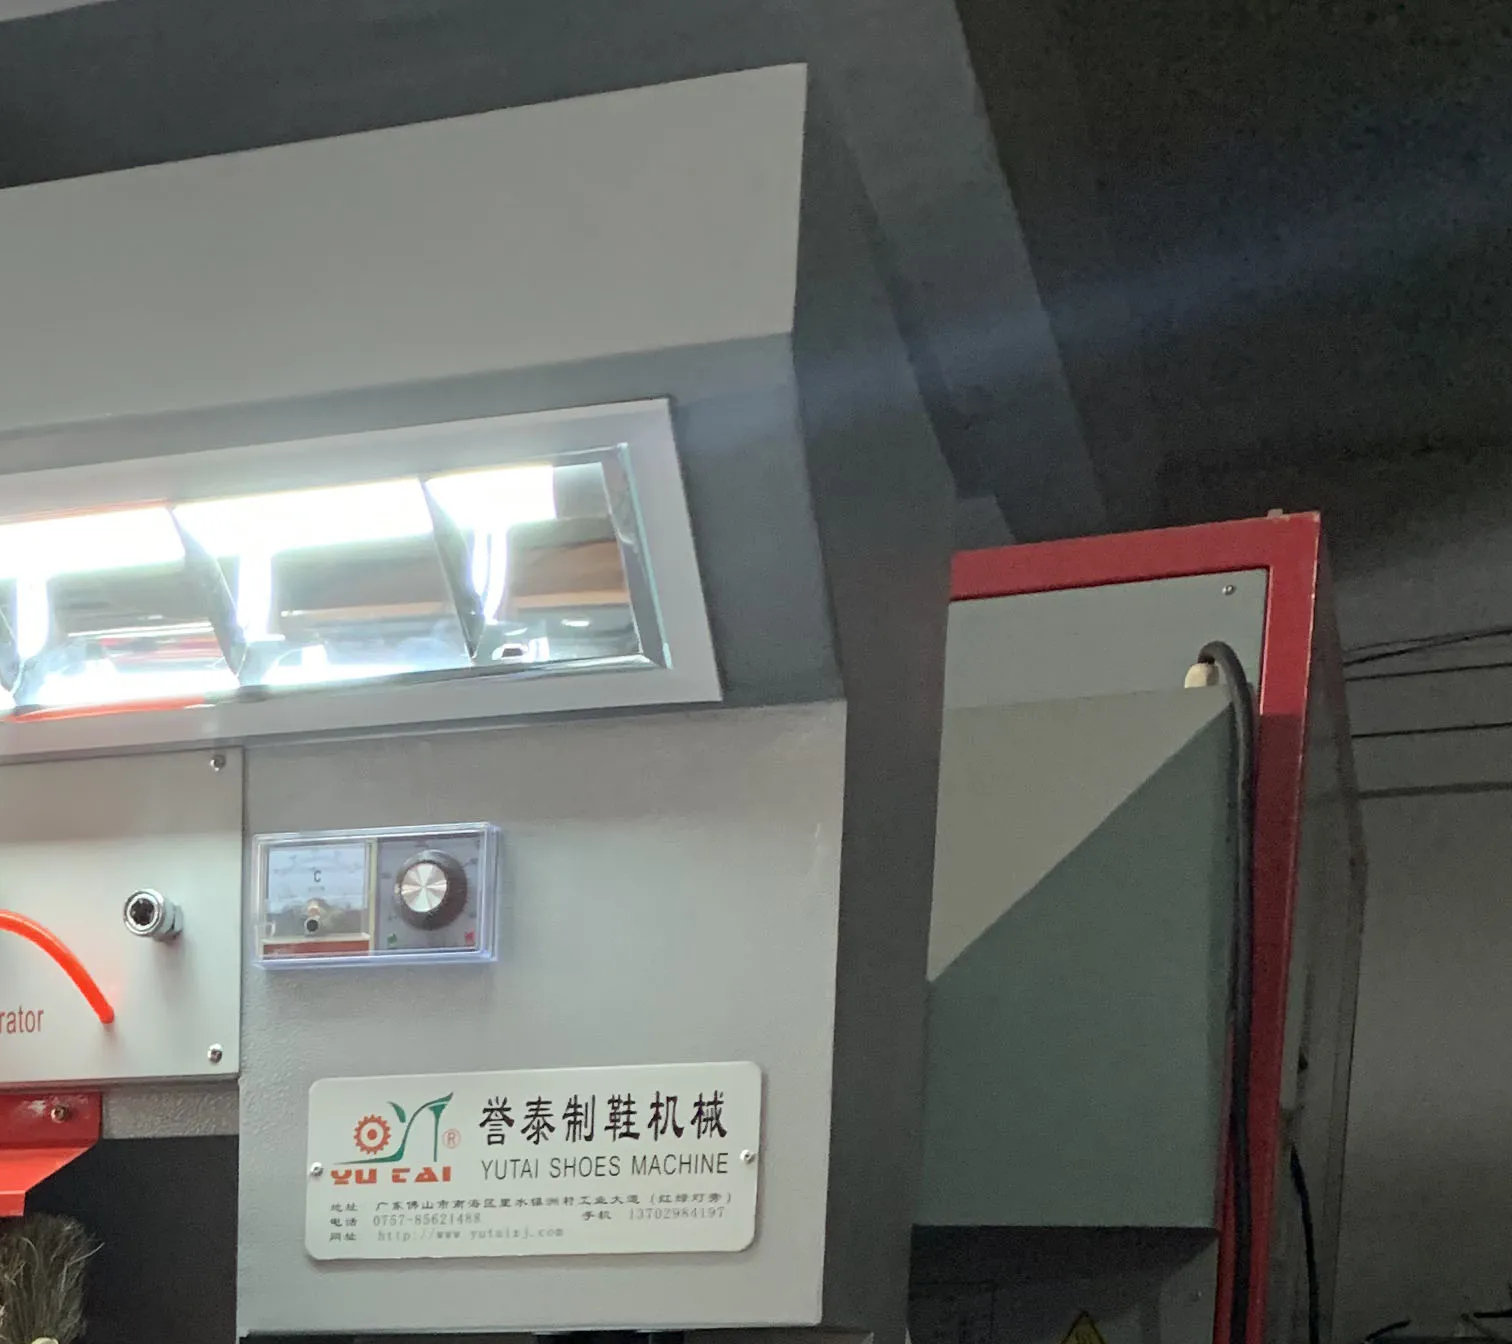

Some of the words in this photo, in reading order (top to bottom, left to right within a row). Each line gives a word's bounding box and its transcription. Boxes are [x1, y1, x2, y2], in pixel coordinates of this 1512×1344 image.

[479, 1090, 728, 1145] 誉泰制鞋机械
[481, 1157, 539, 1181] YUTAI
[549, 1155, 621, 1178] SHOES
[631, 1152, 729, 1177] MACHINE
[329, 1217, 358, 1227] 电话
[582, 1210, 612, 1221] 手机
